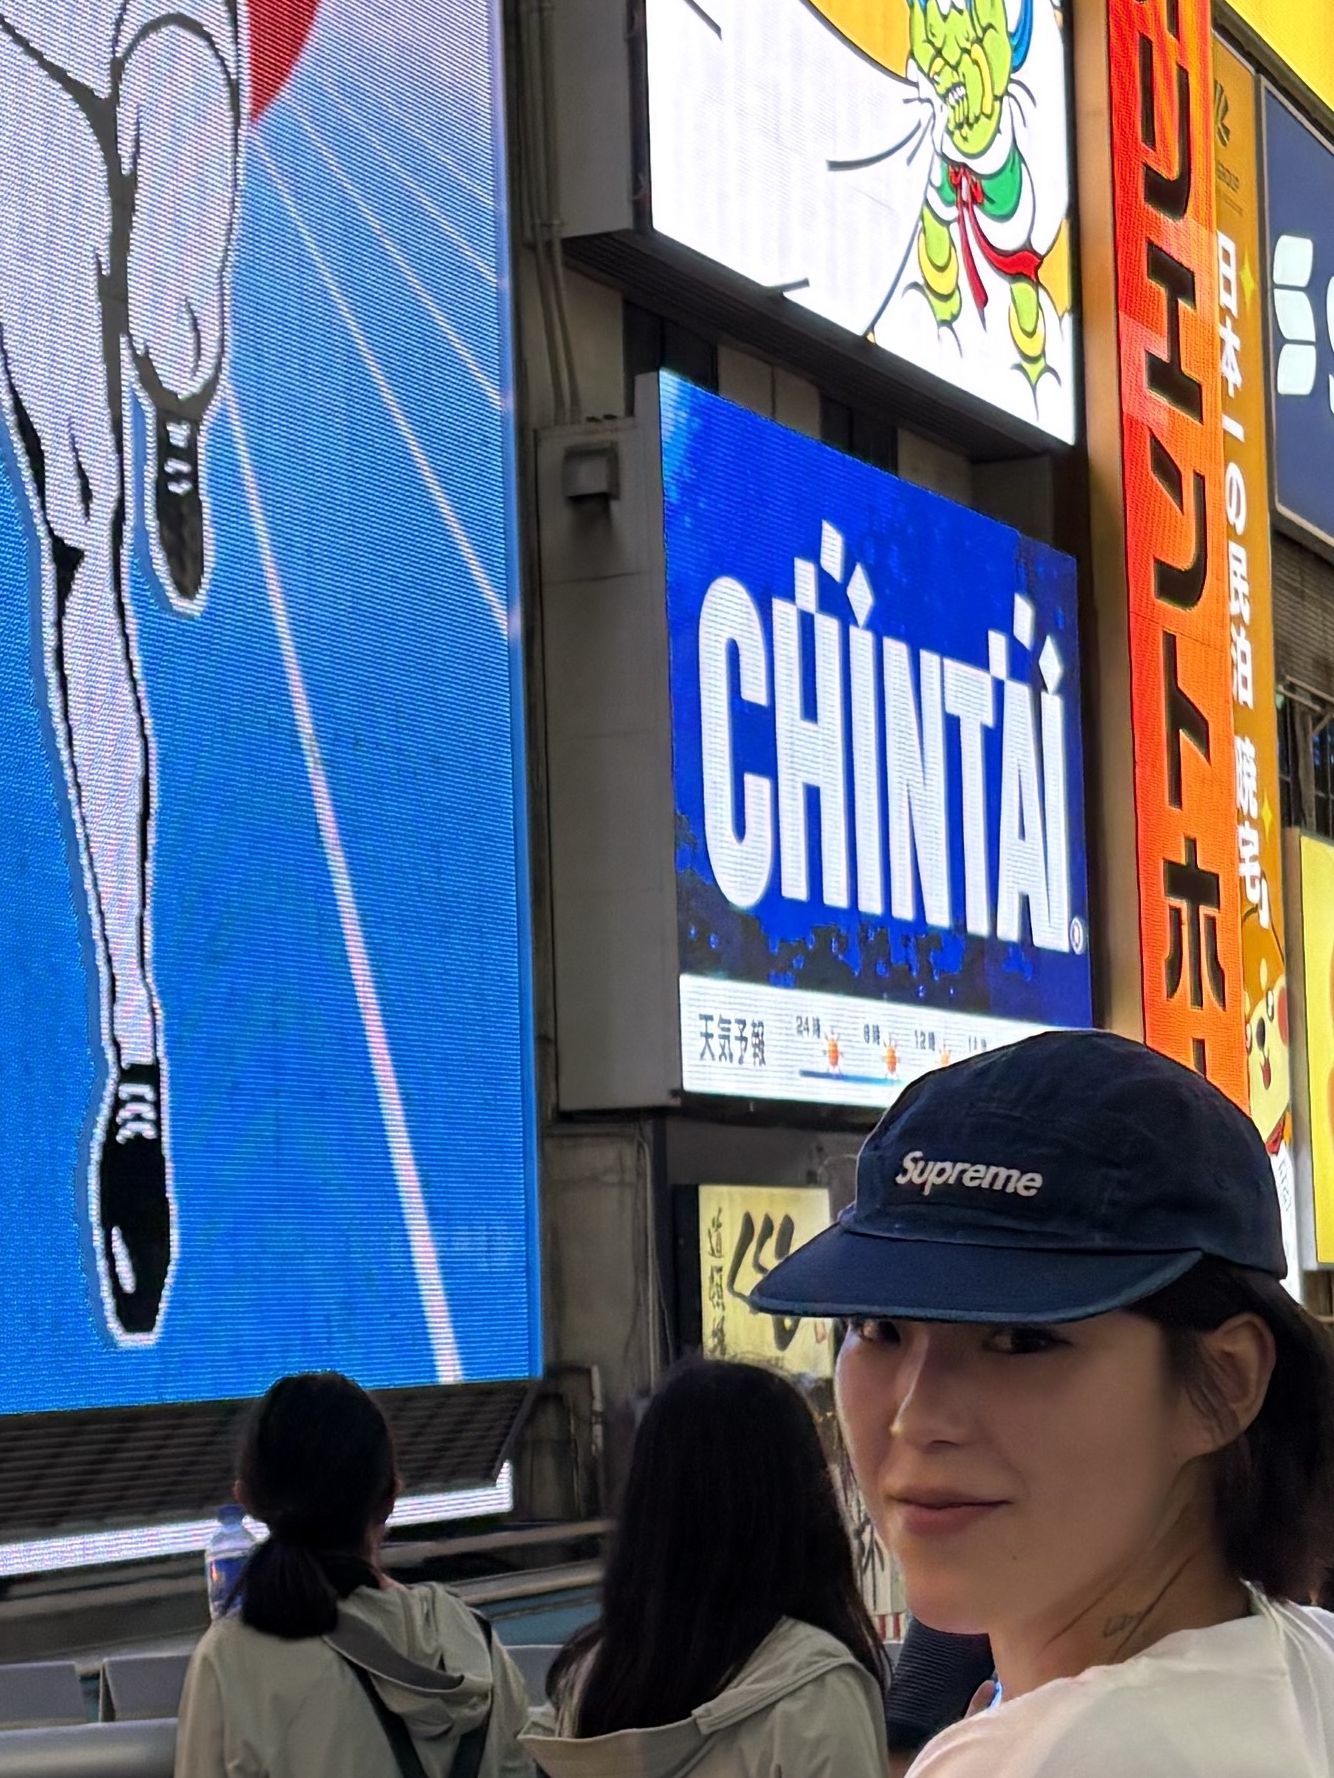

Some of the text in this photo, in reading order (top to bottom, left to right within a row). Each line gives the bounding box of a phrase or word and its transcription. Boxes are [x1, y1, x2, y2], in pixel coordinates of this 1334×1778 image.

[698, 1012, 767, 1068] 天気予報
[895, 1149, 1043, 1198] Supreme
